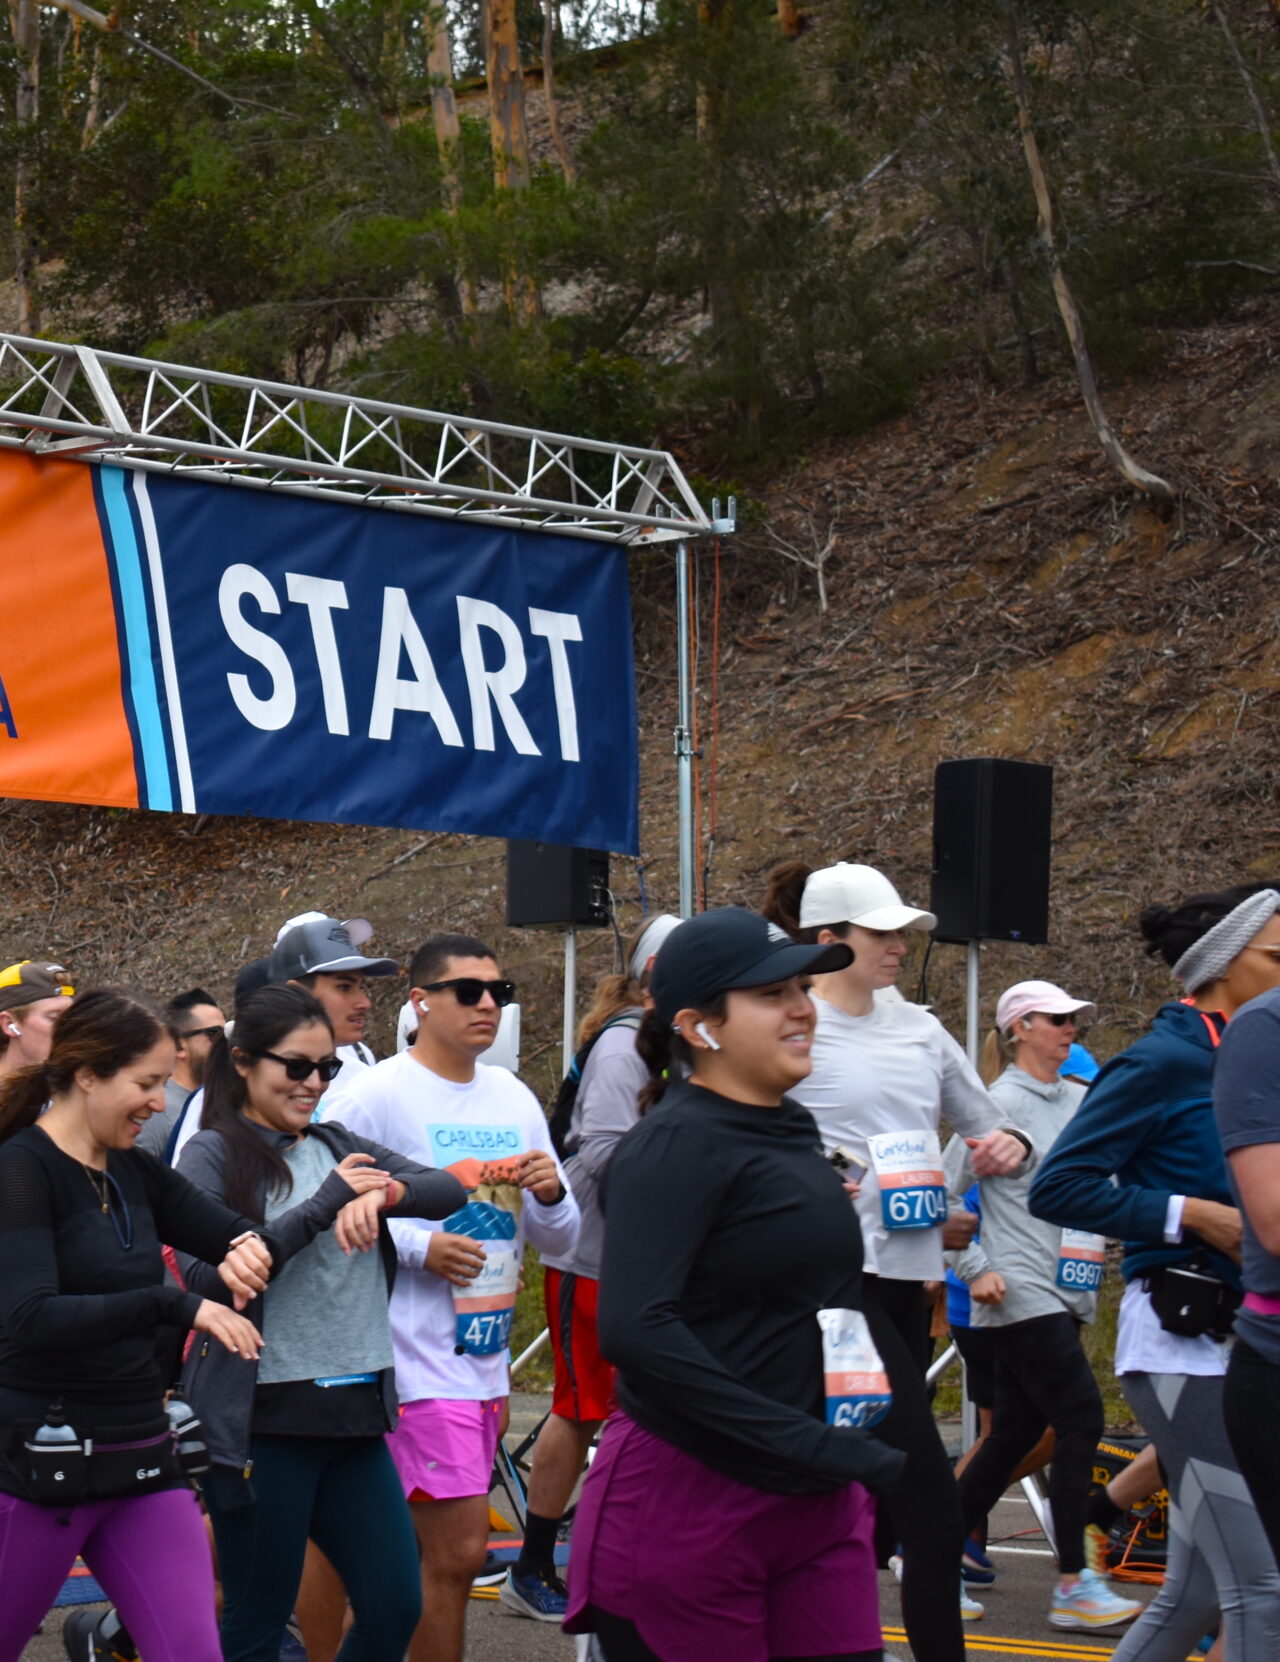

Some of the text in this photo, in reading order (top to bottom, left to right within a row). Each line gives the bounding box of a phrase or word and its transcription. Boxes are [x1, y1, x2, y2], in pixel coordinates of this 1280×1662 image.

[218, 563, 583, 762] START
[435, 1130, 518, 1147] CARLSBAD
[889, 1189, 946, 1221] 6704
[1062, 1261, 1101, 1286] 6997
